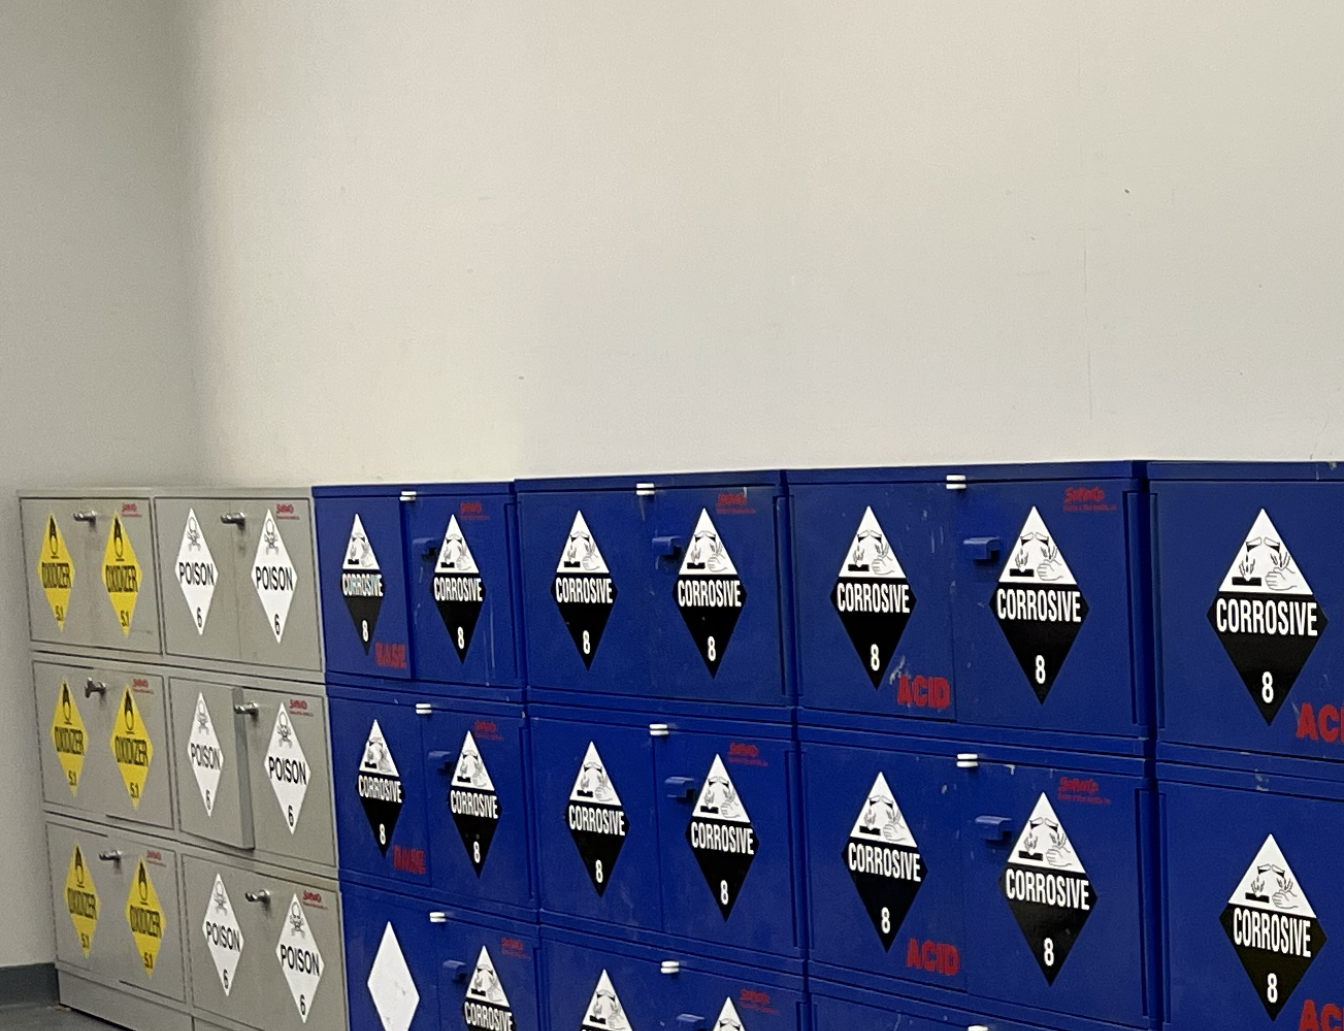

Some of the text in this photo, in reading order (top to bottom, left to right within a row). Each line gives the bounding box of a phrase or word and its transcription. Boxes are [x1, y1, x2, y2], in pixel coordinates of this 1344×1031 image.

[179, 561, 215, 587] POISON
[256, 566, 293, 591] POISON
[342, 573, 383, 597] CORROSIVE
[433, 576, 483, 602] CORROSIVE
[555, 576, 614, 603] CORROSIVE
[677, 579, 742, 607] CORROSIVE
[836, 581, 911, 614] CORROSIVE
[197, 606, 203, 628] 6
[996, 588, 1082, 623] CORROSIVE
[1216, 599, 1318, 637] CORROSIVE
[274, 614, 280, 635] 6
[362, 619, 369, 643] 8
[457, 626, 465, 650] 8
[582, 630, 591, 654] 8
[707, 636, 717, 661] 8
[870, 643, 880, 671] 8
[1035, 654, 1046, 685] 8
[897, 674, 951, 709] ACID
[1261, 671, 1274, 704] 8
[190, 742, 221, 770] POISON
[268, 755, 307, 785] POISON
[205, 789, 212, 810] 6
[358, 774, 403, 804] CORROSIVE
[288, 804, 294, 826] 6
[450, 789, 499, 819] CORROSIVE
[379, 823, 387, 845] 8
[568, 804, 626, 836] CORROSIVE
[473, 840, 481, 864] 8
[690, 821, 755, 855] CORROSIVE
[595, 859, 604, 883] 8
[847, 842, 922, 882] CORROSIVE
[720, 879, 729, 906] 8
[1005, 867, 1090, 911] CORROSIVE
[880, 906, 891, 934] 8
[1232, 907, 1312, 959] CORROSIVE
[206, 921, 241, 952] POISON
[280, 944, 320, 976] POISON
[906, 937, 960, 976] ACID
[1043, 937, 1055, 966] 8
[223, 968, 229, 990] 6
[1267, 972, 1278, 1004] 8
[300, 993, 306, 1016] 6
